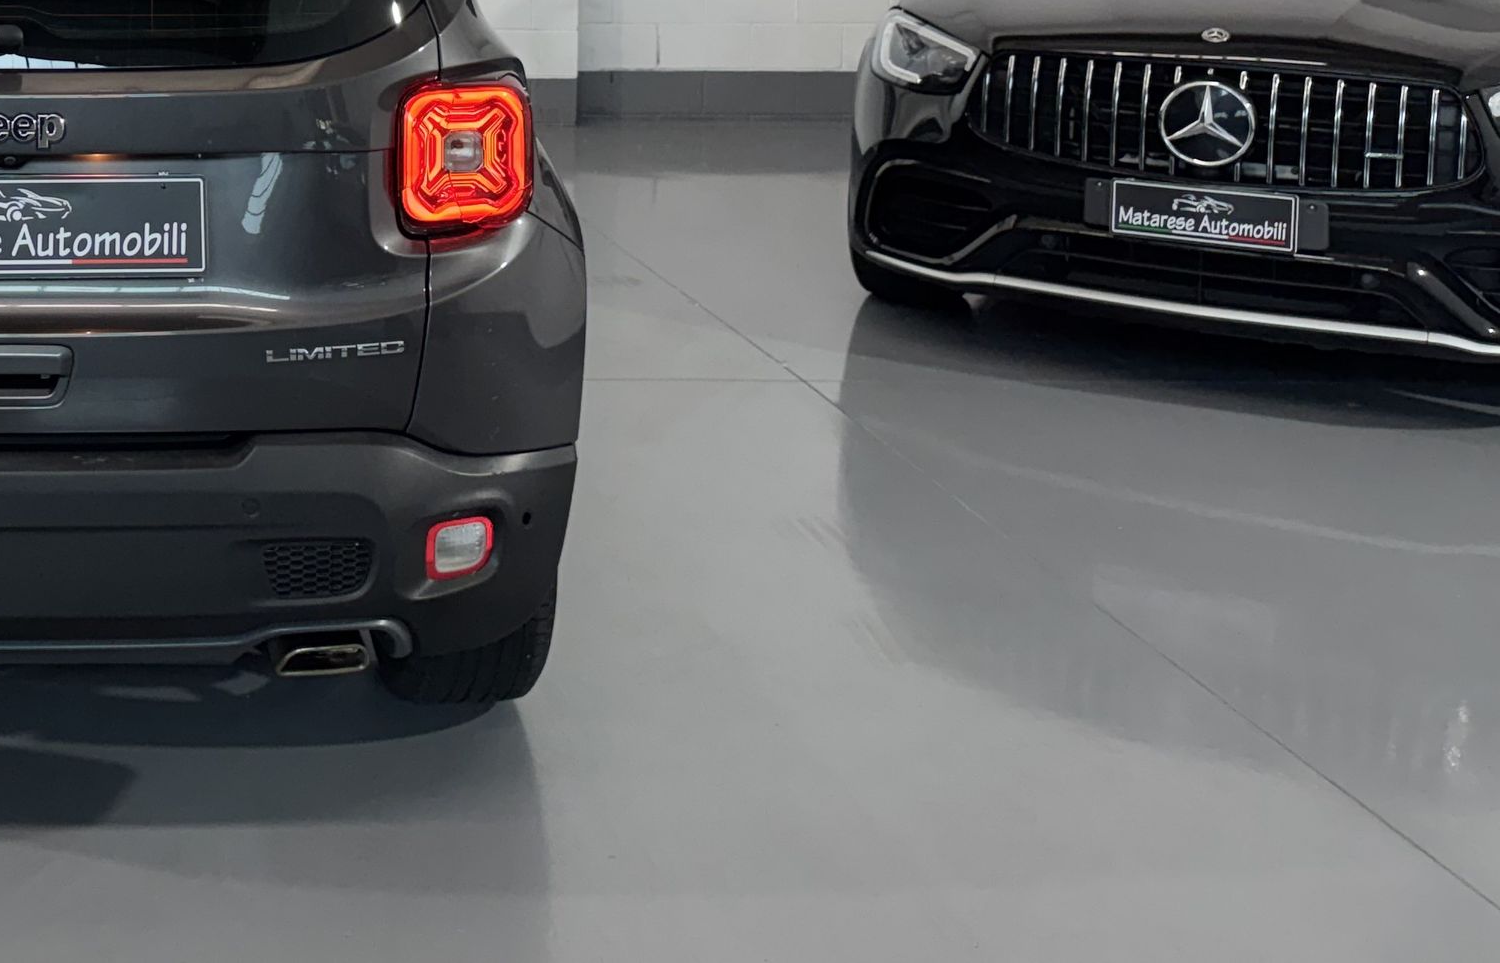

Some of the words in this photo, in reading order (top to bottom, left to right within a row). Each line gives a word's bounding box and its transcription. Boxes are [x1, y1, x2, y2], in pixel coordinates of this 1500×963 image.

[12, 222, 188, 258] Automobili
[1118, 206, 1195, 231] Matarese
[1199, 215, 1287, 241] Automobili
[265, 340, 404, 363] LIMITED
